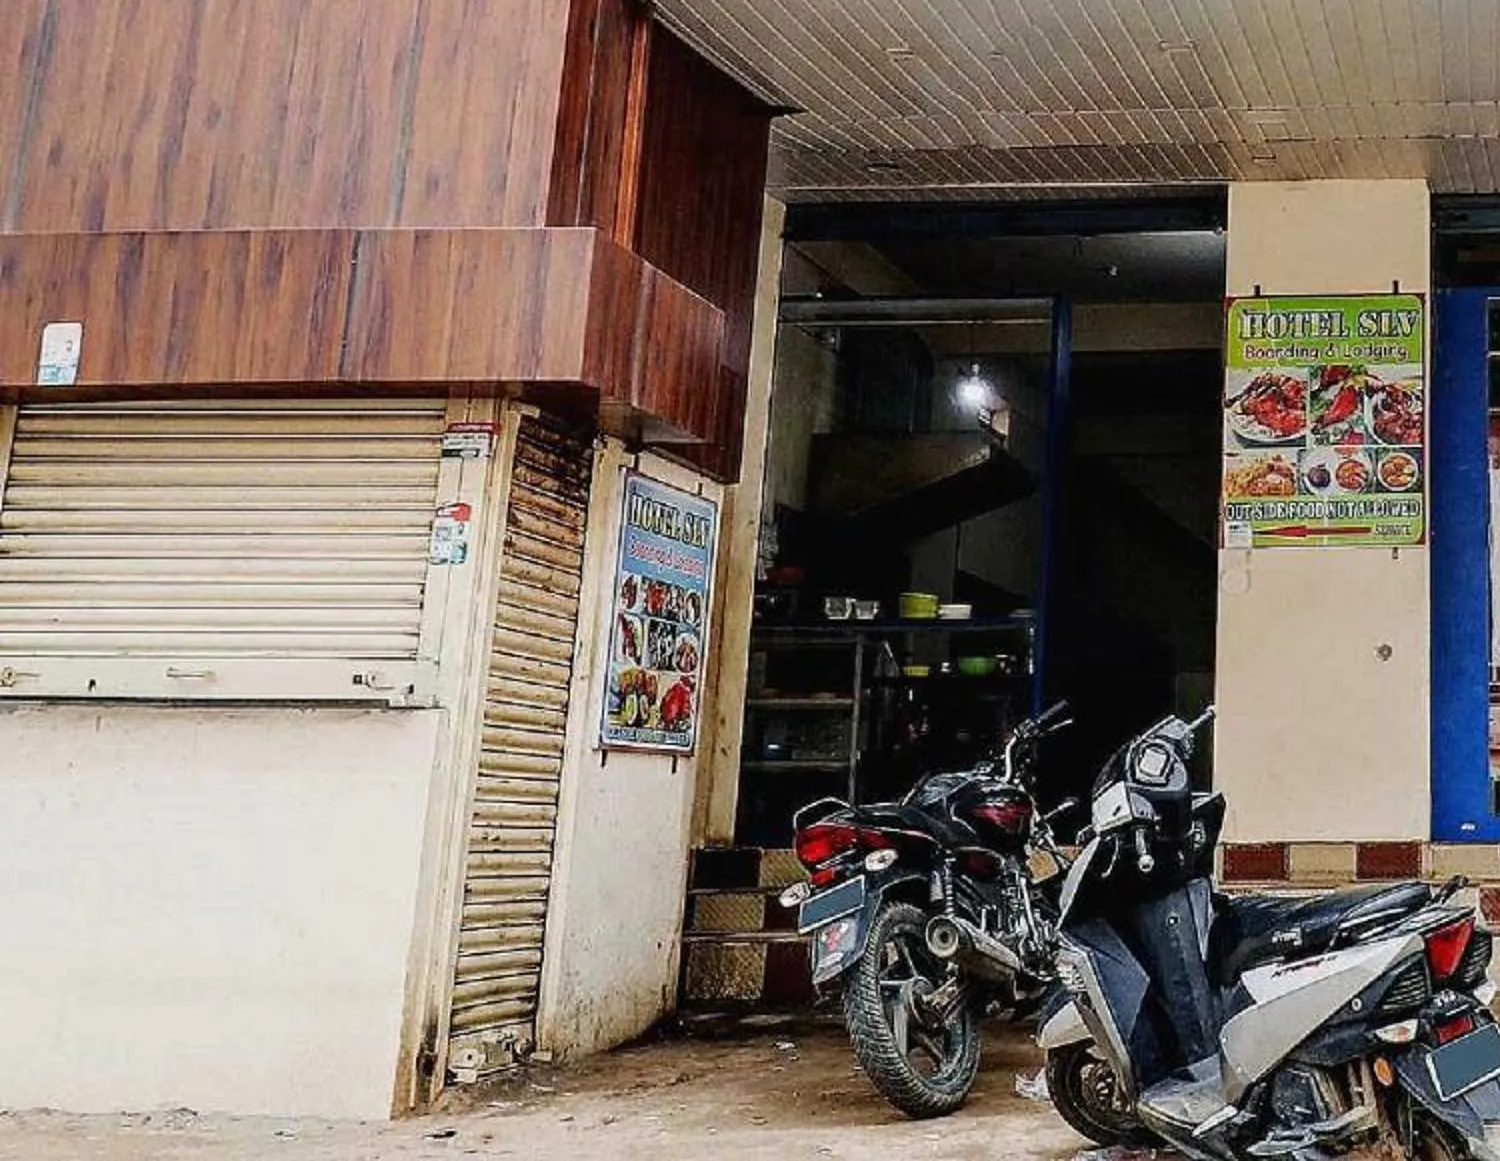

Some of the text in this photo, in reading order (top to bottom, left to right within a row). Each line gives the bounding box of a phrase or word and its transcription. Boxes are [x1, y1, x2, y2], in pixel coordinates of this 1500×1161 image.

[1239, 308, 1420, 340] HOTEL SLV
[1289, 501, 1327, 519] FOOD
